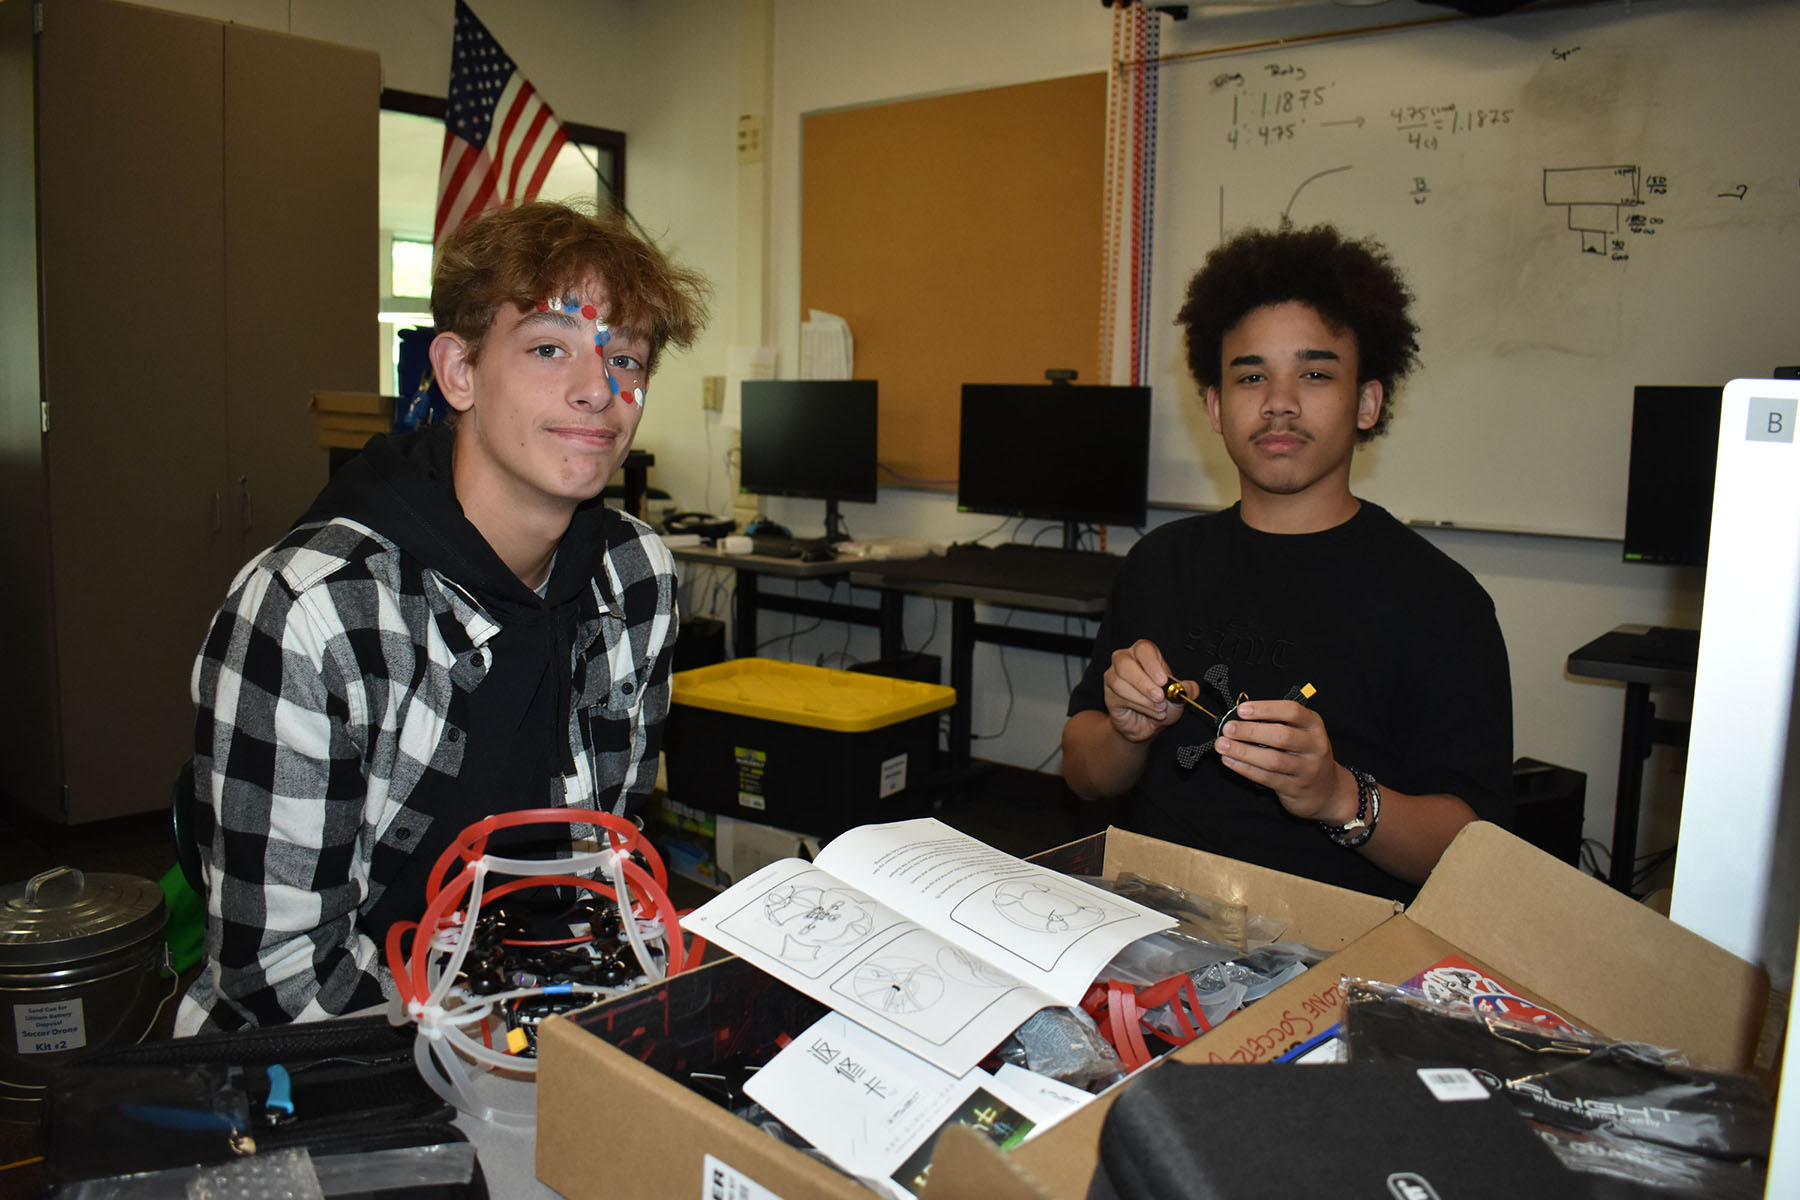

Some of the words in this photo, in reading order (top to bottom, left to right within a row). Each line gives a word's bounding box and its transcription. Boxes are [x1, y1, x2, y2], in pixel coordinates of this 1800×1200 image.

[1767, 412, 1783, 434] B
[52, 1026, 79, 1036] Drone
[36, 1043, 52, 1052] Kit
[806, 1038, 887, 1099] 返修卡
